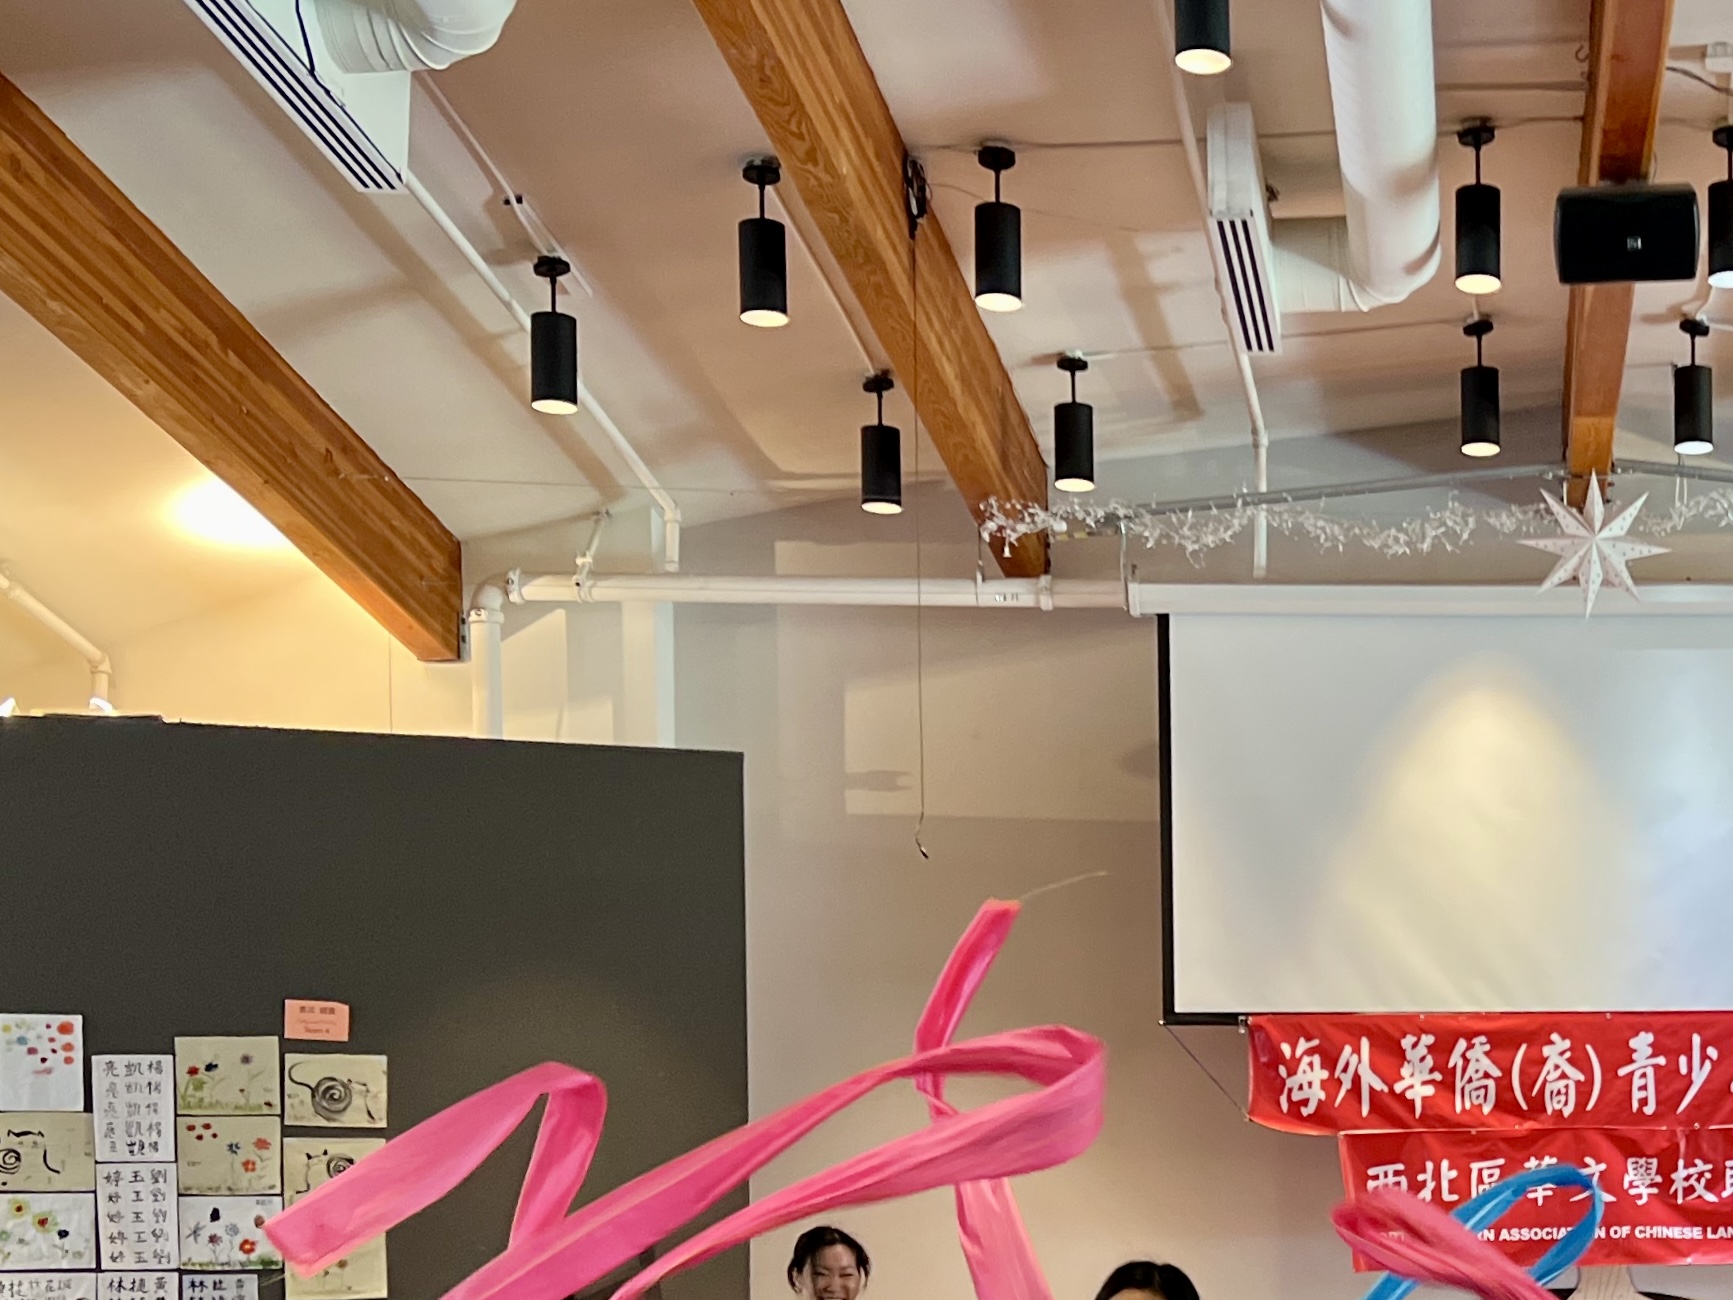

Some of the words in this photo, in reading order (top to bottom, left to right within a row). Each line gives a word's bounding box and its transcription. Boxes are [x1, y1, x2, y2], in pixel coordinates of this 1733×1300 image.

[1499, 1227, 1605, 1241] ASSOCIAN
[1609, 1225, 1631, 1239] OF
[1634, 1225, 1704, 1240] CHINESE
